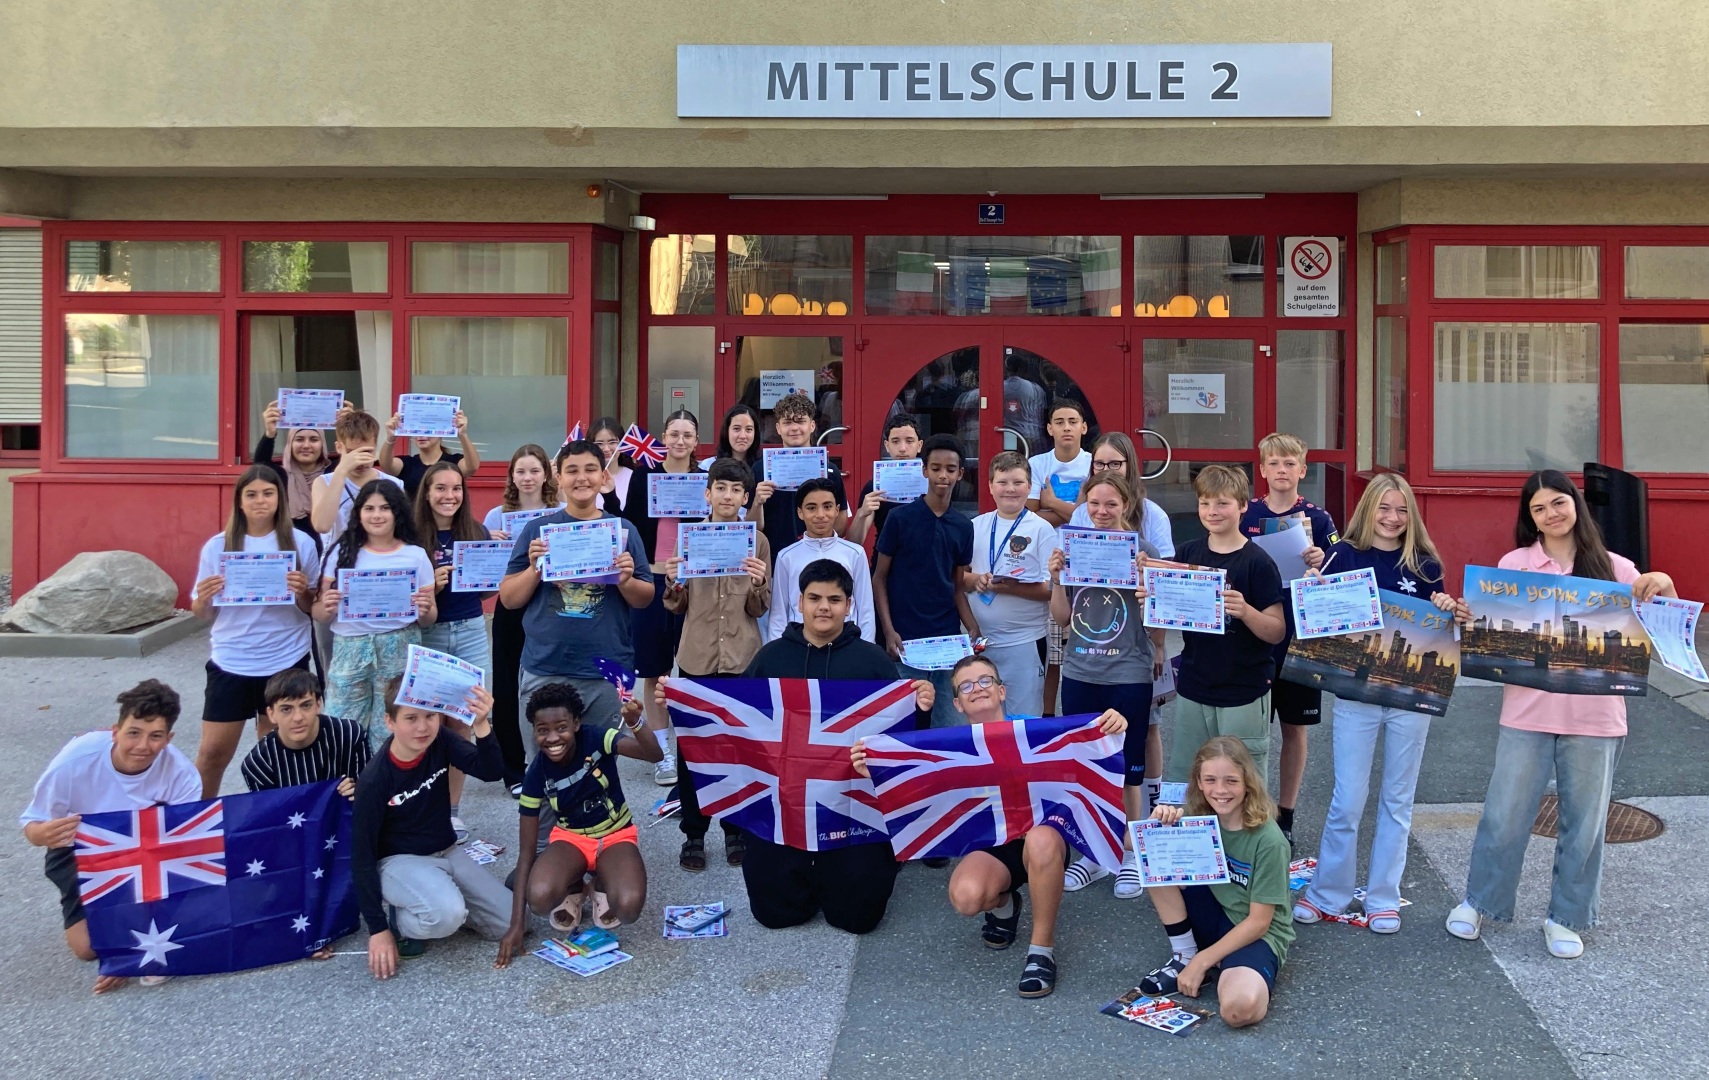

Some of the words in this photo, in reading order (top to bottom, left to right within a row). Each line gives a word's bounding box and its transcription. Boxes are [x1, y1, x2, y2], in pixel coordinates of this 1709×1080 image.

[767, 60, 1186, 102] MITTELSCHULE
[1210, 61, 1240, 101] 2
[987, 205, 996, 216] 2
[1286, 302, 1337, 311] Schulgelände
[1479, 579, 1519, 598] NEW
[1586, 591, 1631, 609] CITY
[1107, 648, 1120, 656] ARE
[388, 767, 447, 806] Champion
[830, 830, 847, 840] BIG
[847, 826, 877, 837] Challenge
